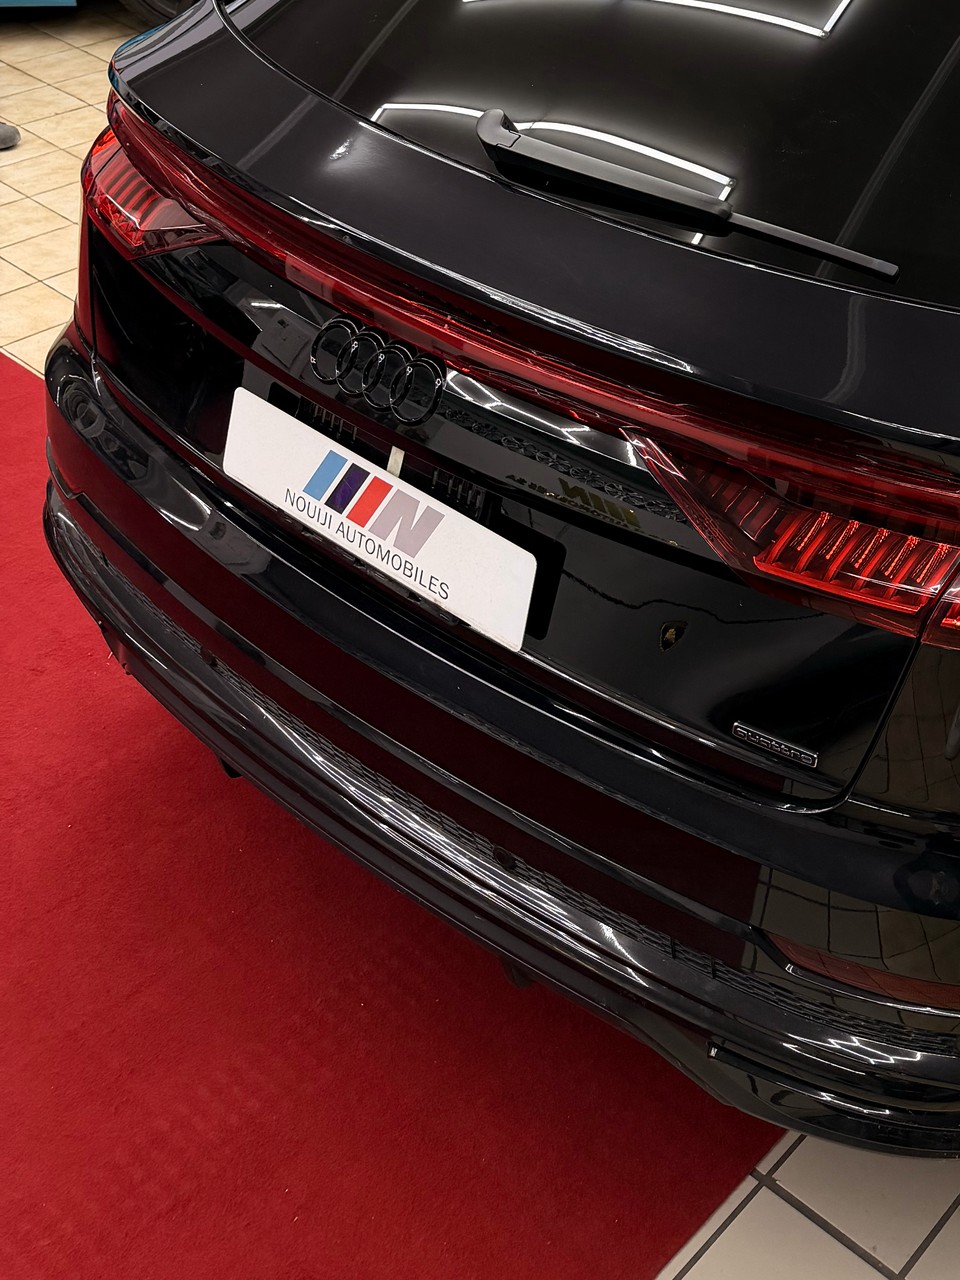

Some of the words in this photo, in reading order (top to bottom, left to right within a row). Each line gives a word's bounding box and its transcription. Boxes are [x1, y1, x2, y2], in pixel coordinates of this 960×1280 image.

[284, 488, 333, 530] NOUIJI
[335, 521, 450, 600] AUTOMOBILES
[735, 727, 813, 766] quattro
